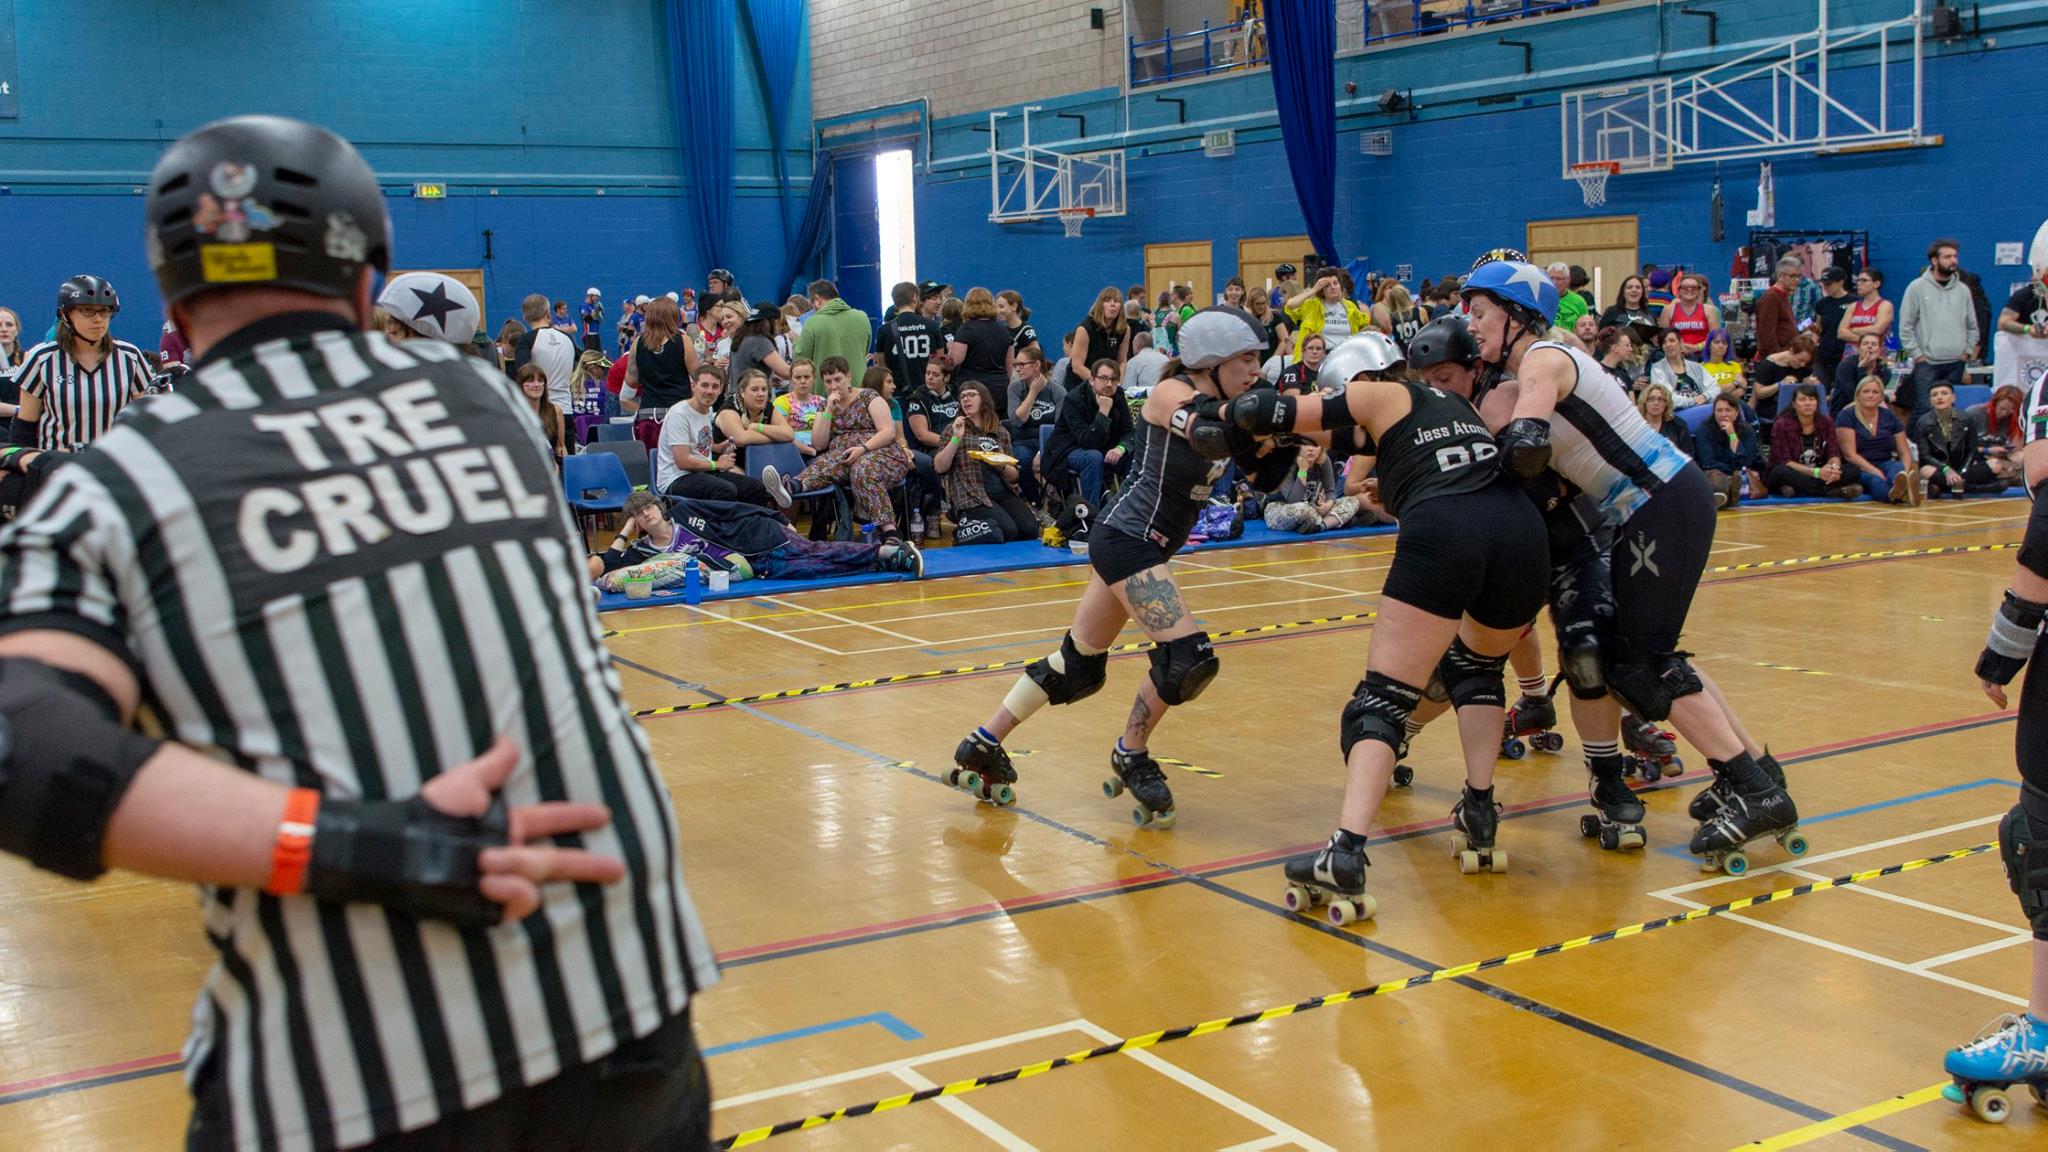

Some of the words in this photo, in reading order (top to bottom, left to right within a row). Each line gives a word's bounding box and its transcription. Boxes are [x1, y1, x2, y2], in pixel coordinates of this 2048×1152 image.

[1284, 373, 1296, 383] 73
[253, 379, 466, 471] TRE
[1414, 427, 1450, 445] Jess
[239, 445, 548, 573] CRUEL
